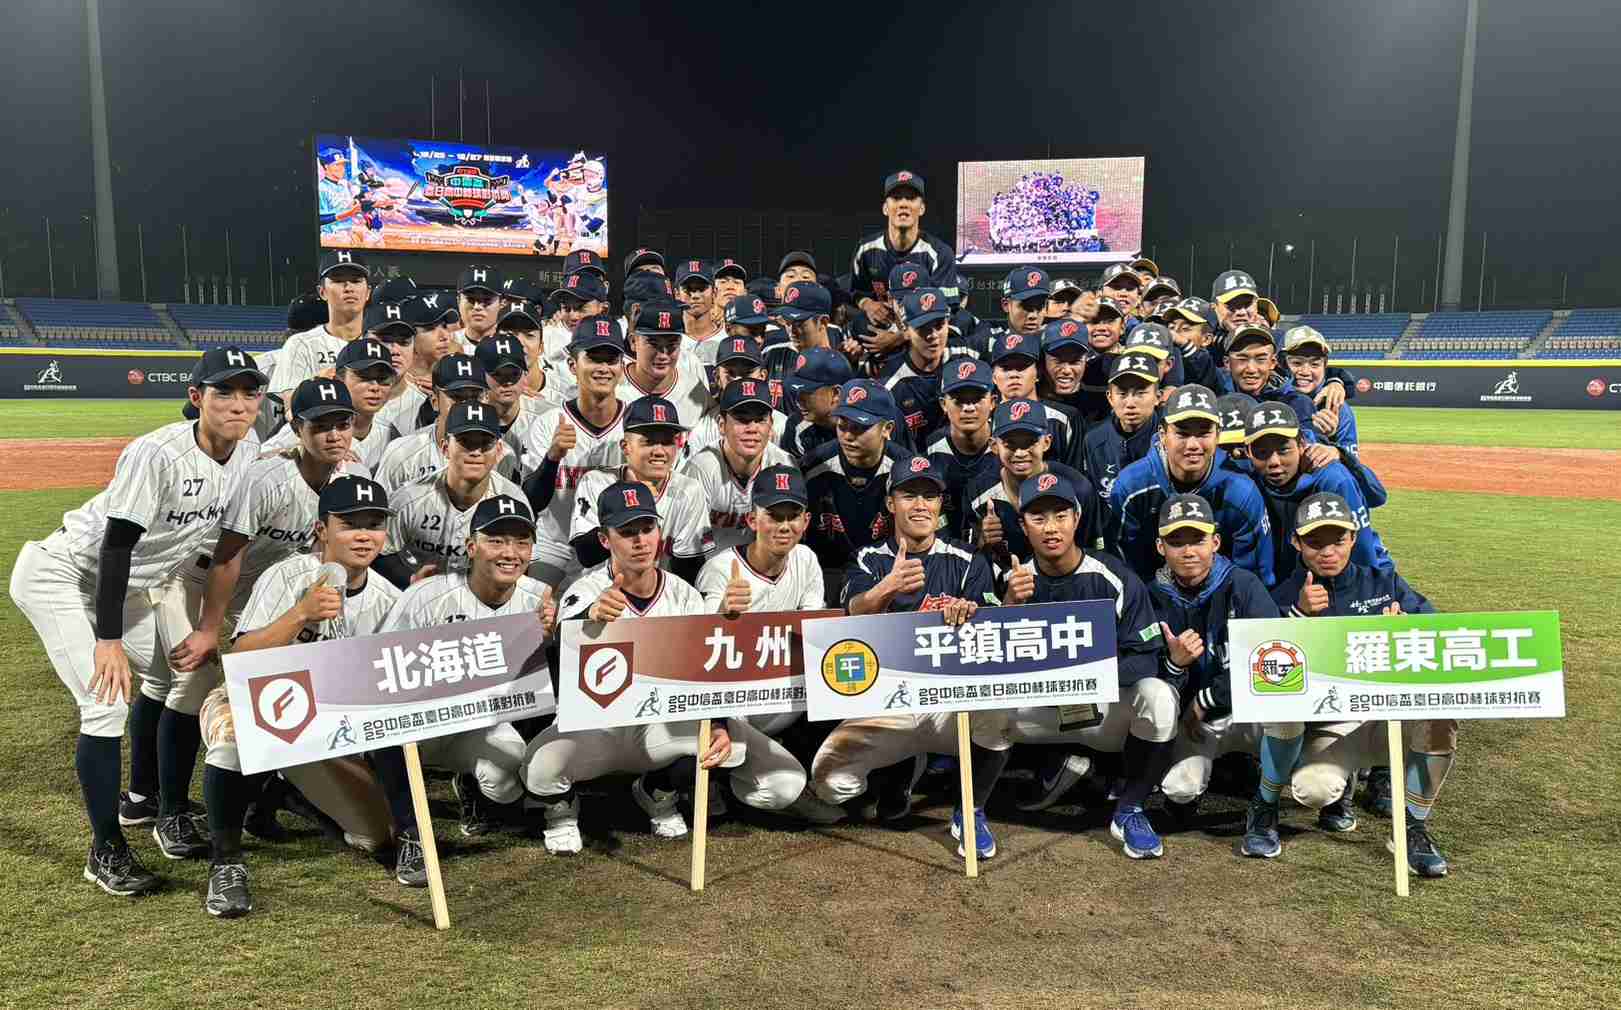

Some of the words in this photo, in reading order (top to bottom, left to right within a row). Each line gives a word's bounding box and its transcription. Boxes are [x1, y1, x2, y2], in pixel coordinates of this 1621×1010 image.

[338, 251, 351, 263] H
[473, 269, 487, 282] H
[386, 305, 400, 319] H
[367, 343, 381, 358] H
[496, 340, 511, 354] H
[226, 350, 246, 366] H
[317, 351, 336, 363] 25
[457, 361, 472, 376] H
[148, 372, 177, 382] CTBC
[318, 384, 336, 400] H
[467, 405, 483, 421] H
[1219, 411, 1245, 428] 工
[183, 478, 205, 497] 27
[355, 484, 374, 501] H
[499, 499, 516, 514] H
[420, 514, 441, 531] 22
[704, 624, 792, 672] 九州
[914, 616, 1093, 667] 平鎮高中
[1345, 628, 1537, 673] 羅東高工
[373, 632, 508, 693] 北海道
